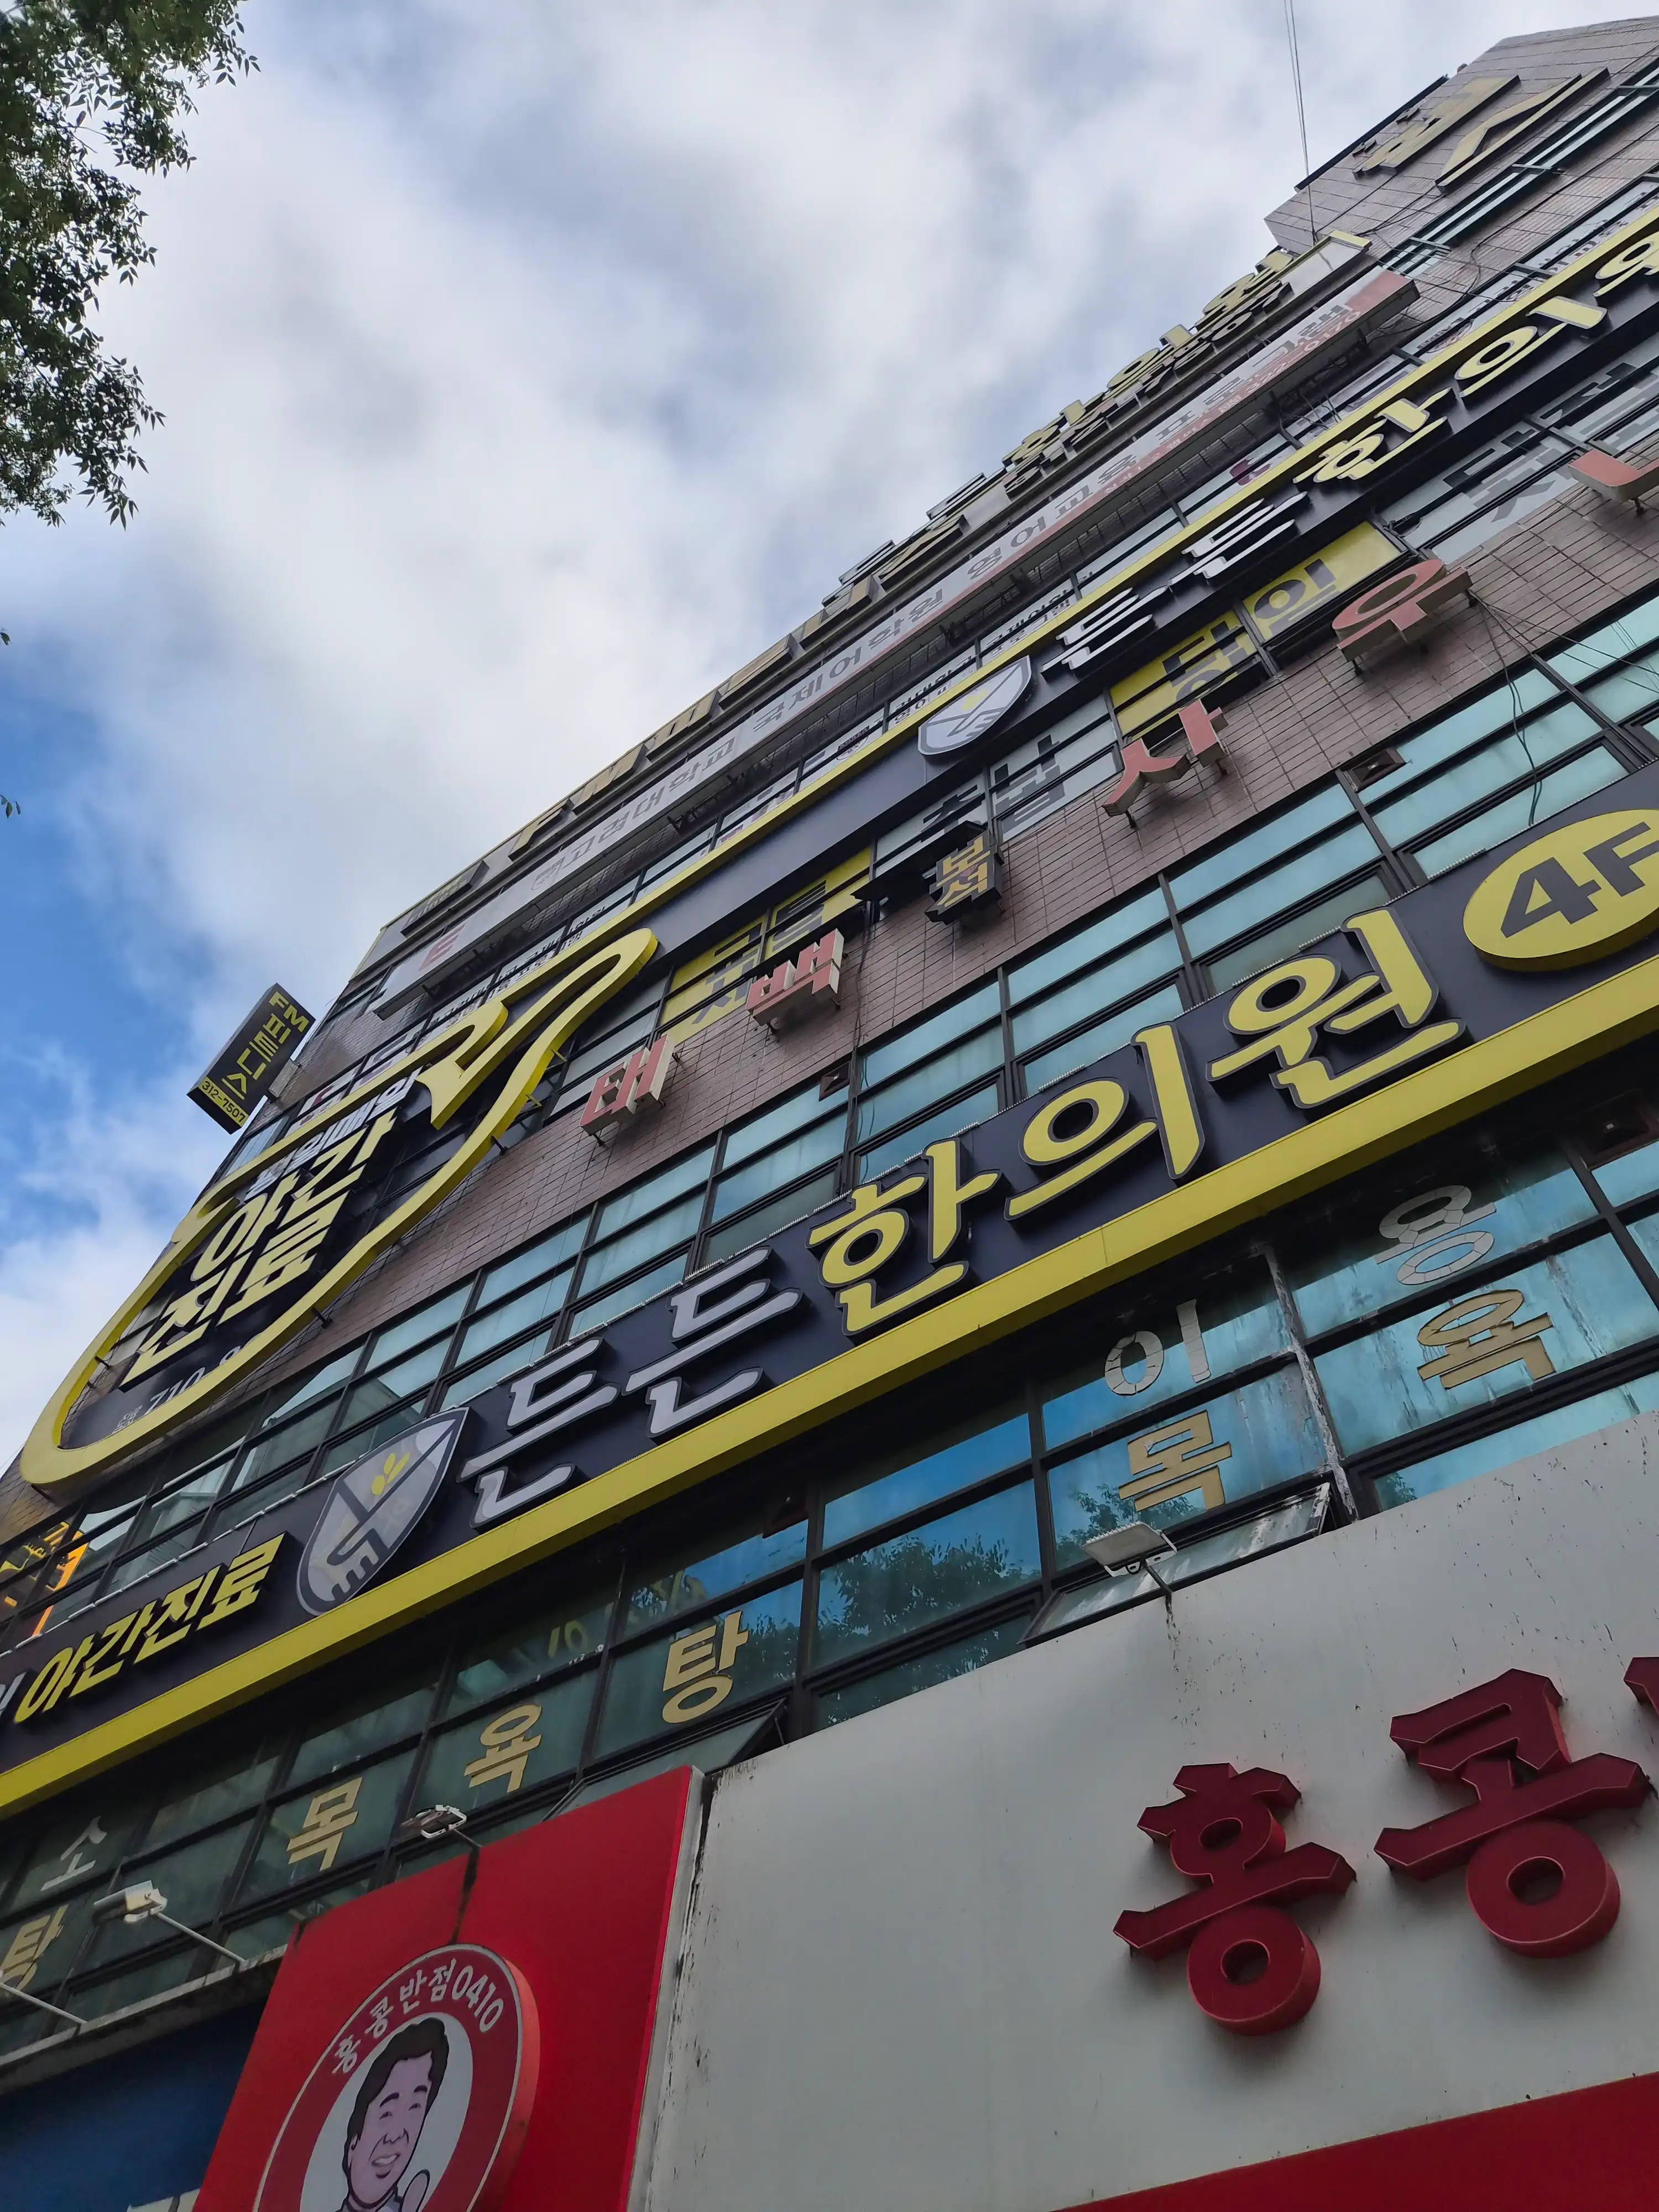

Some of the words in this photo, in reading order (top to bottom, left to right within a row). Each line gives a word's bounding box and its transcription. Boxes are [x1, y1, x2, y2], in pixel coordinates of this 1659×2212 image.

[1246, 311, 1361, 392] 322-0170
[753, 588, 943, 732] 국제어학원
[967, 453, 1138, 580] 영어교육
[1155, 304, 1351, 439] 프로그램
[1500, 821, 1659, 938] 4F
[221, 1013, 291, 1100] 피트니스
[269, 991, 310, 1033] FM
[580, 928, 842, 1131] 태백
[201, 1080, 247, 1123] 312-7507
[190, 1107, 398, 1281] 야간
[456, 905, 1466, 1533] 튼튼한의원
[119, 1190, 349, 1386] 진료
[14, 1533, 285, 1724] 야간진료
